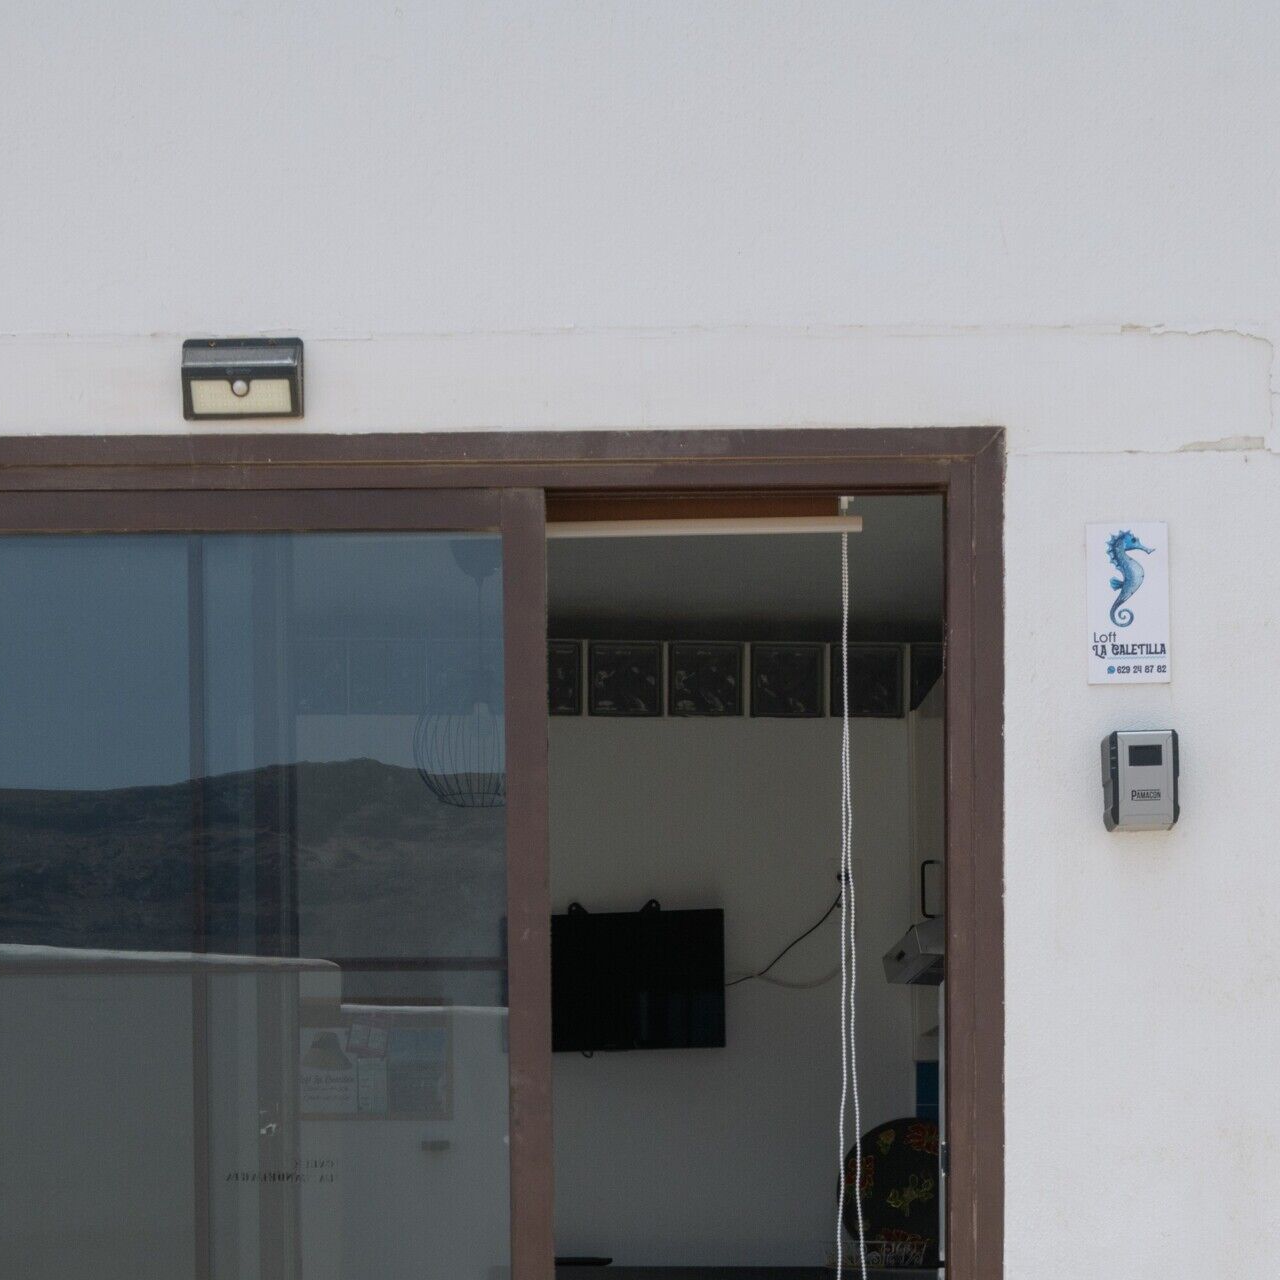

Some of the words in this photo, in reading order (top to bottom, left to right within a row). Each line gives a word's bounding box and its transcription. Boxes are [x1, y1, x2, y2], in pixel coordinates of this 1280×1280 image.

[1093, 631, 1117, 643] Loft
[1092, 644, 1107, 659] LA
[1111, 643, 1166, 656] CALETILLA
[1117, 665, 1131, 674] 629
[1133, 665, 1143, 674] 24
[1144, 665, 1155, 673] 87
[1156, 664, 1167, 673] 82
